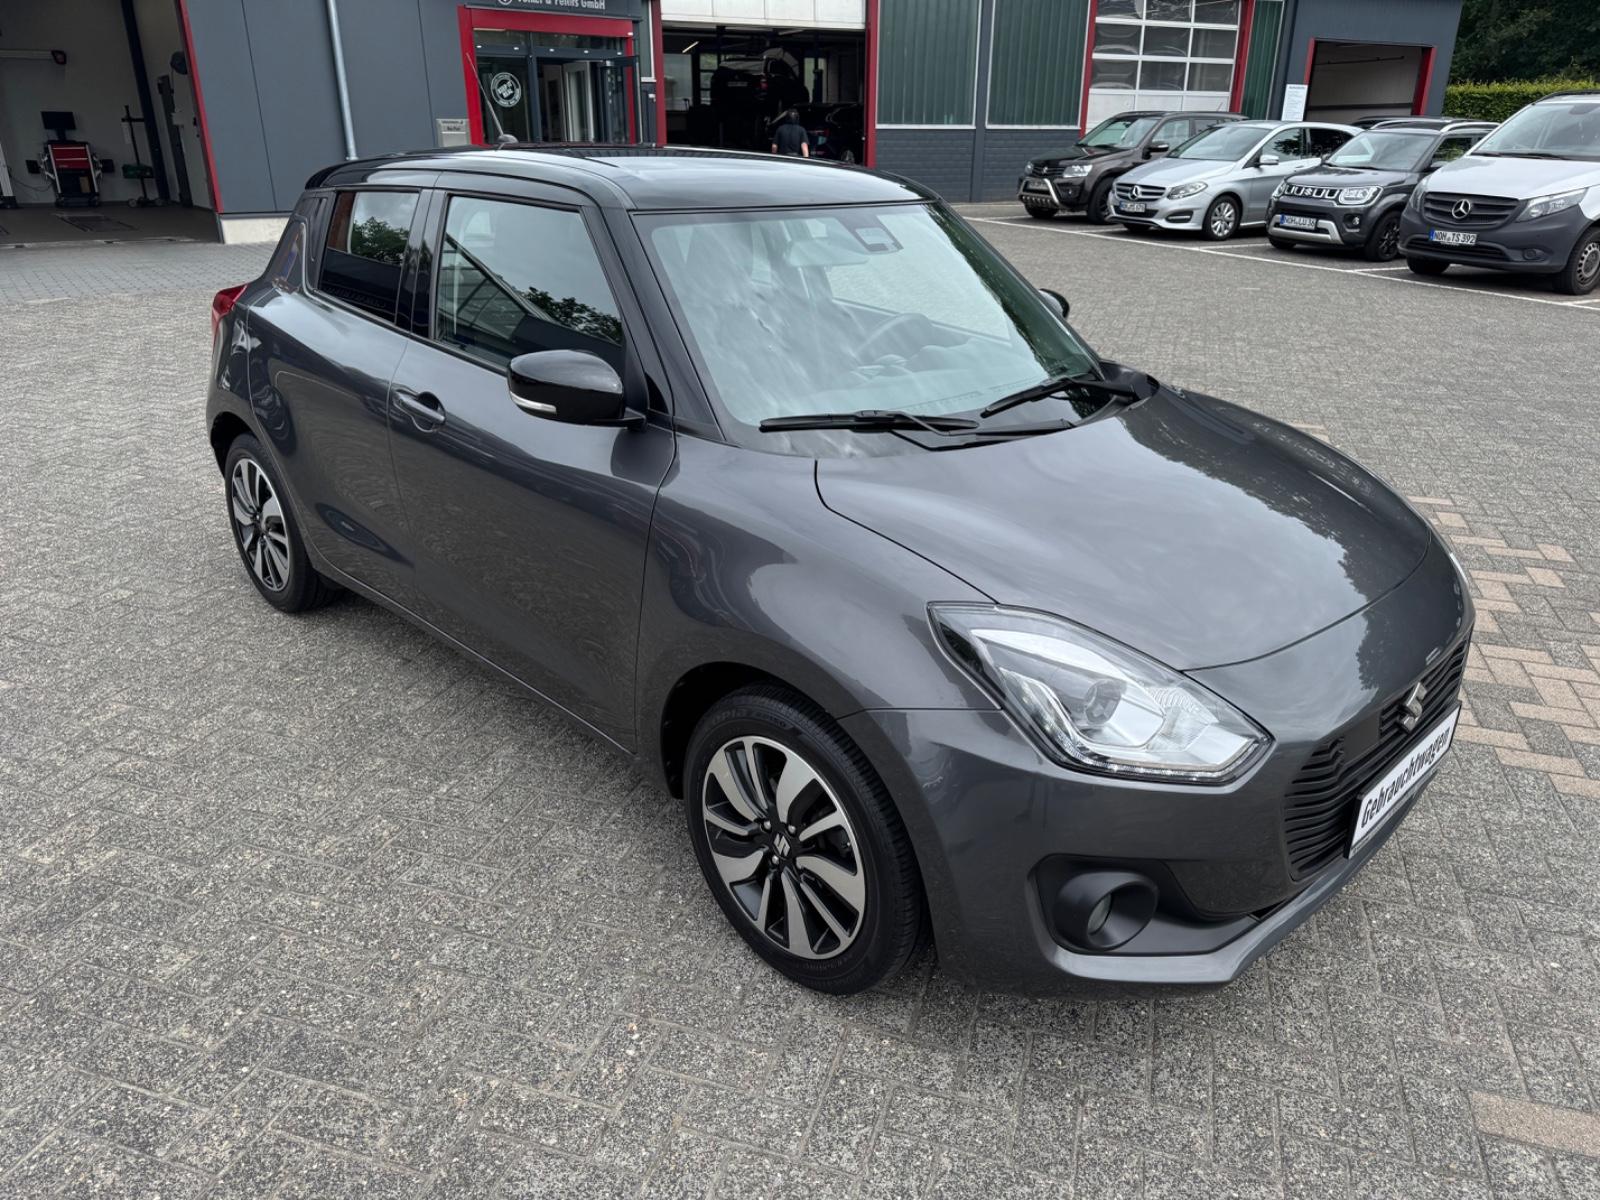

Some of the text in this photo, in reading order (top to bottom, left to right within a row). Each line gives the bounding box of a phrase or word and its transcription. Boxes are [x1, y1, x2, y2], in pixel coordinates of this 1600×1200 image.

[581, 0, 606, 9] GmbH
[1434, 231, 1476, 244] NOH TS 392
[1361, 726, 1451, 828] Gebrauchtwagen
